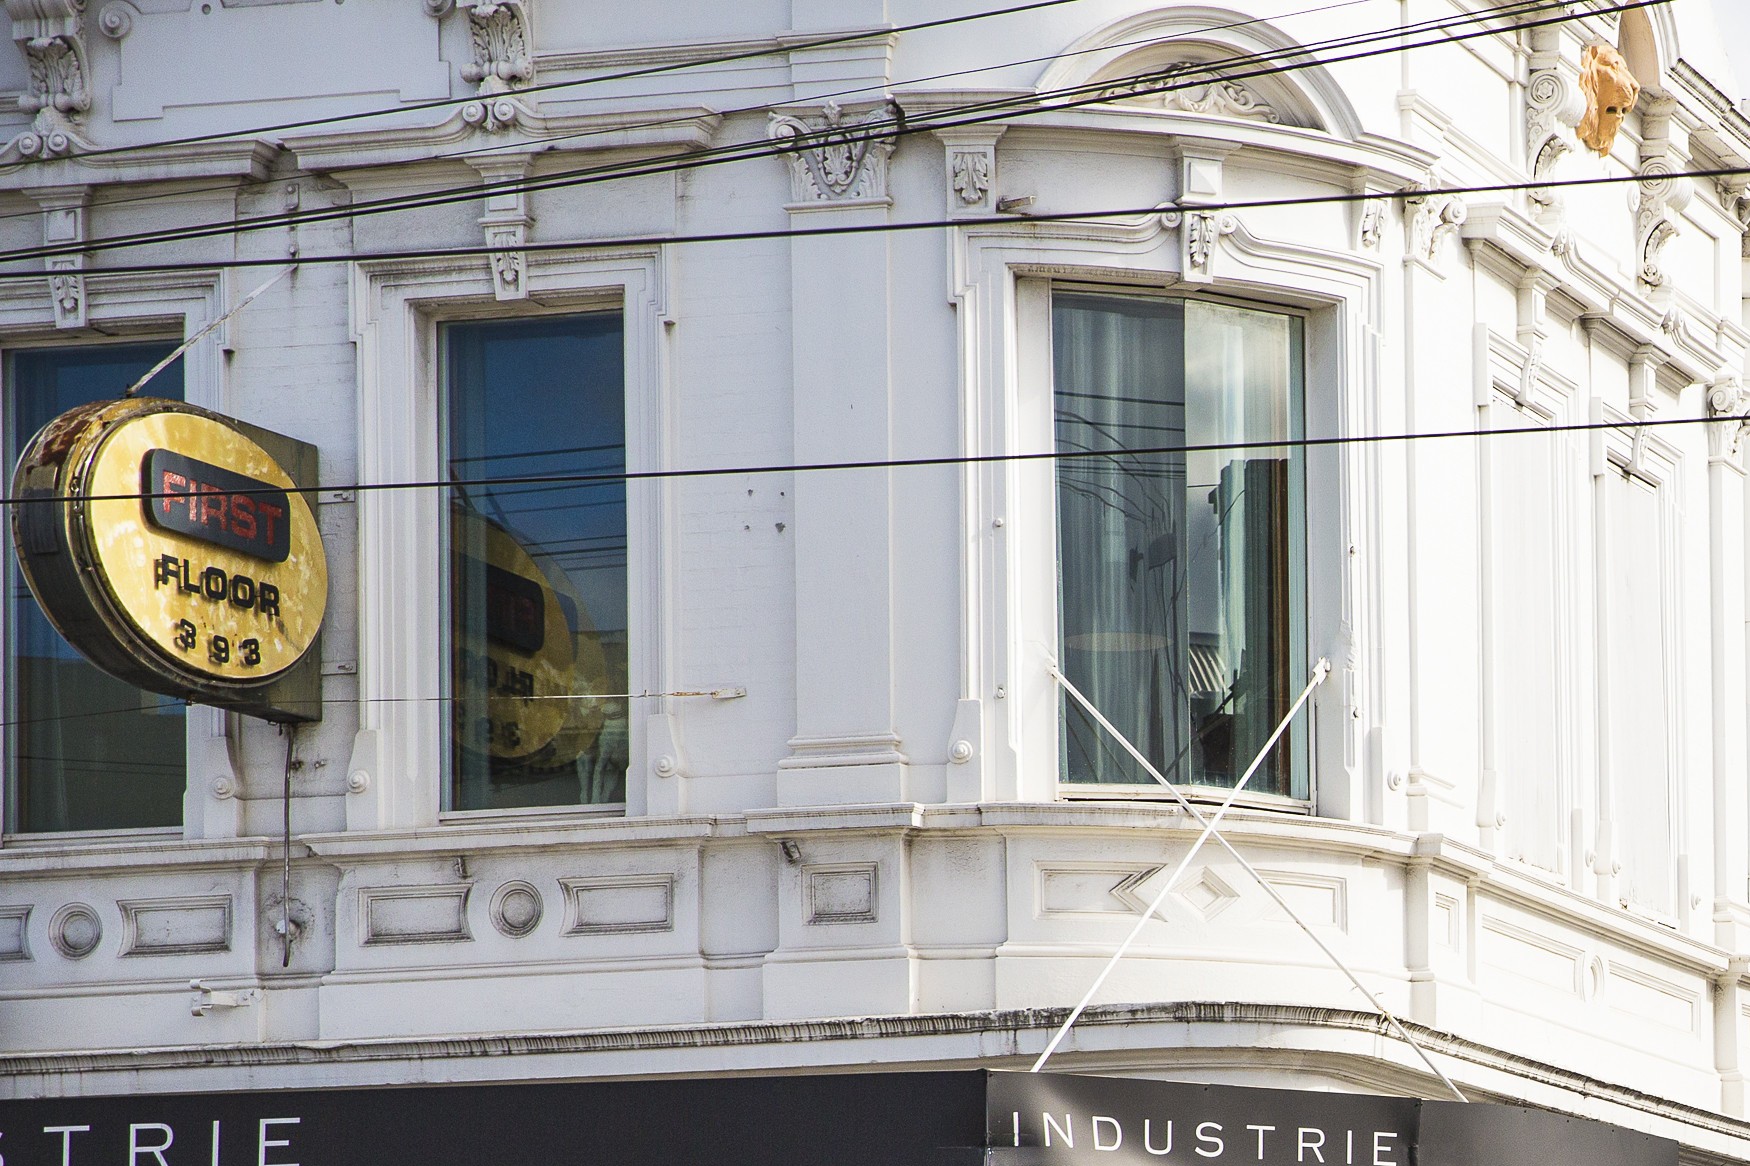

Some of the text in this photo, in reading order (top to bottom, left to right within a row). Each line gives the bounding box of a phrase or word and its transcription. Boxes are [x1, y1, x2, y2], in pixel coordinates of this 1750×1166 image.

[163, 470, 282, 545] FIRST
[161, 553, 280, 617] FLOOR
[1012, 1111, 1398, 1166] INDUSTRIE
